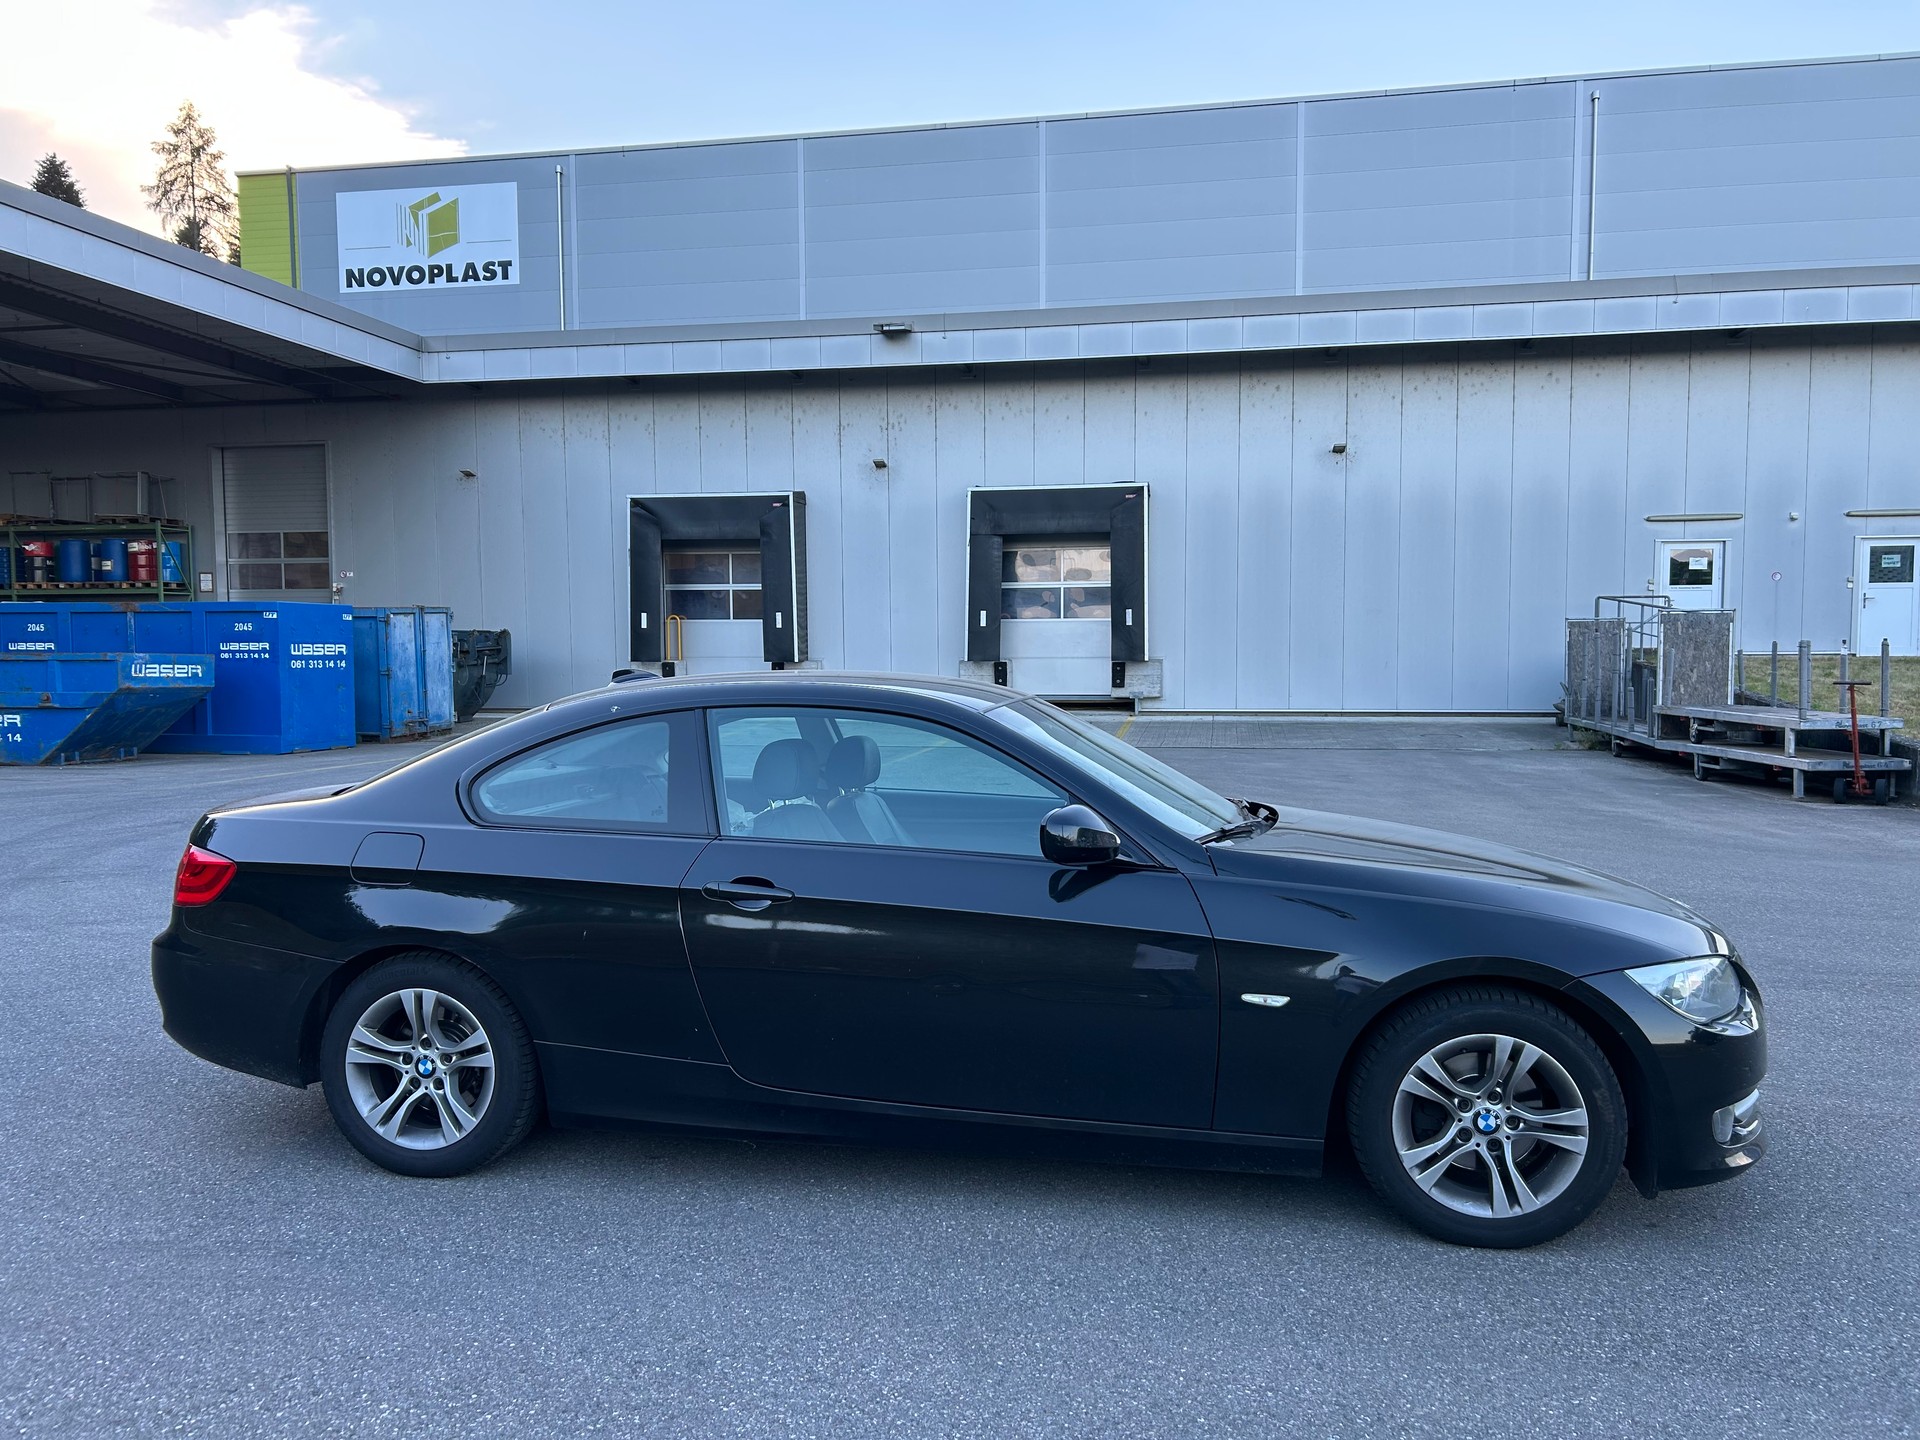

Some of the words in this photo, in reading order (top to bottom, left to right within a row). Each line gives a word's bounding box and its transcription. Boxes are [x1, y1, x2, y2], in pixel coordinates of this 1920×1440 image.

[345, 260, 512, 288] NOVOPLAST
[27, 623, 45, 632] 2045
[234, 622, 252, 631] 2045
[290, 659, 306, 669] 061
[308, 659, 323, 669] 313
[325, 659, 335, 668] 14
[337, 659, 346, 668] 14
[6, 733, 22, 742] 14
